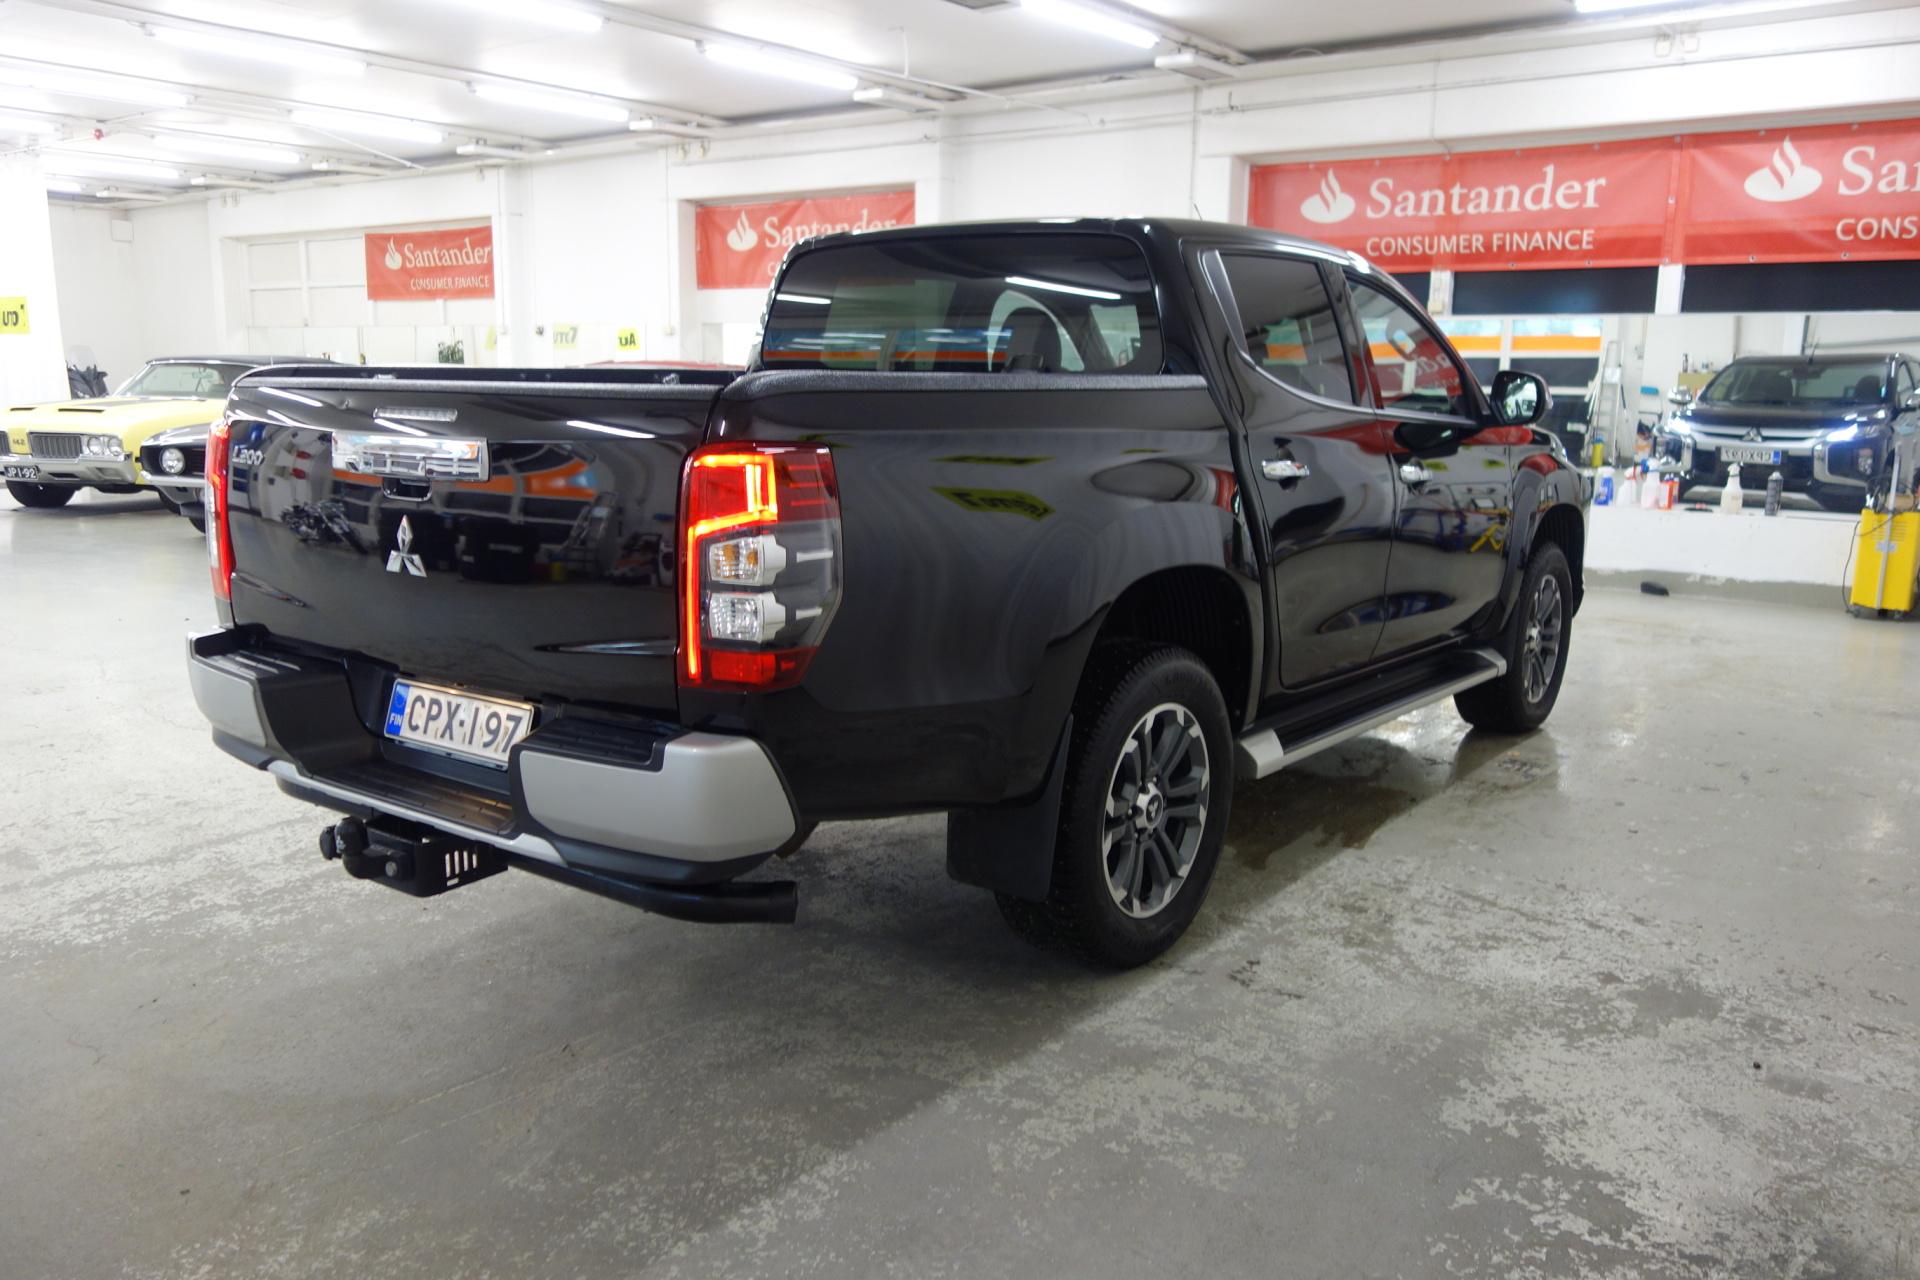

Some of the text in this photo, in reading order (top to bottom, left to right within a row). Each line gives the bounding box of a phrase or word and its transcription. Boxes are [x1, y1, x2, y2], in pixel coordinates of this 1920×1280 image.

[1838, 145, 1920, 196] Sa
[1366, 163, 1607, 219] Santander
[1836, 214, 1919, 241] CONS
[404, 237, 492, 269] Santander
[1366, 229, 1596, 257] CONSUMER FINANCE
[410, 274, 490, 291] CONSUMER FINANCE
[232, 444, 264, 466] L200
[389, 713, 404, 726] FIN
[407, 694, 523, 753] CPX-197
